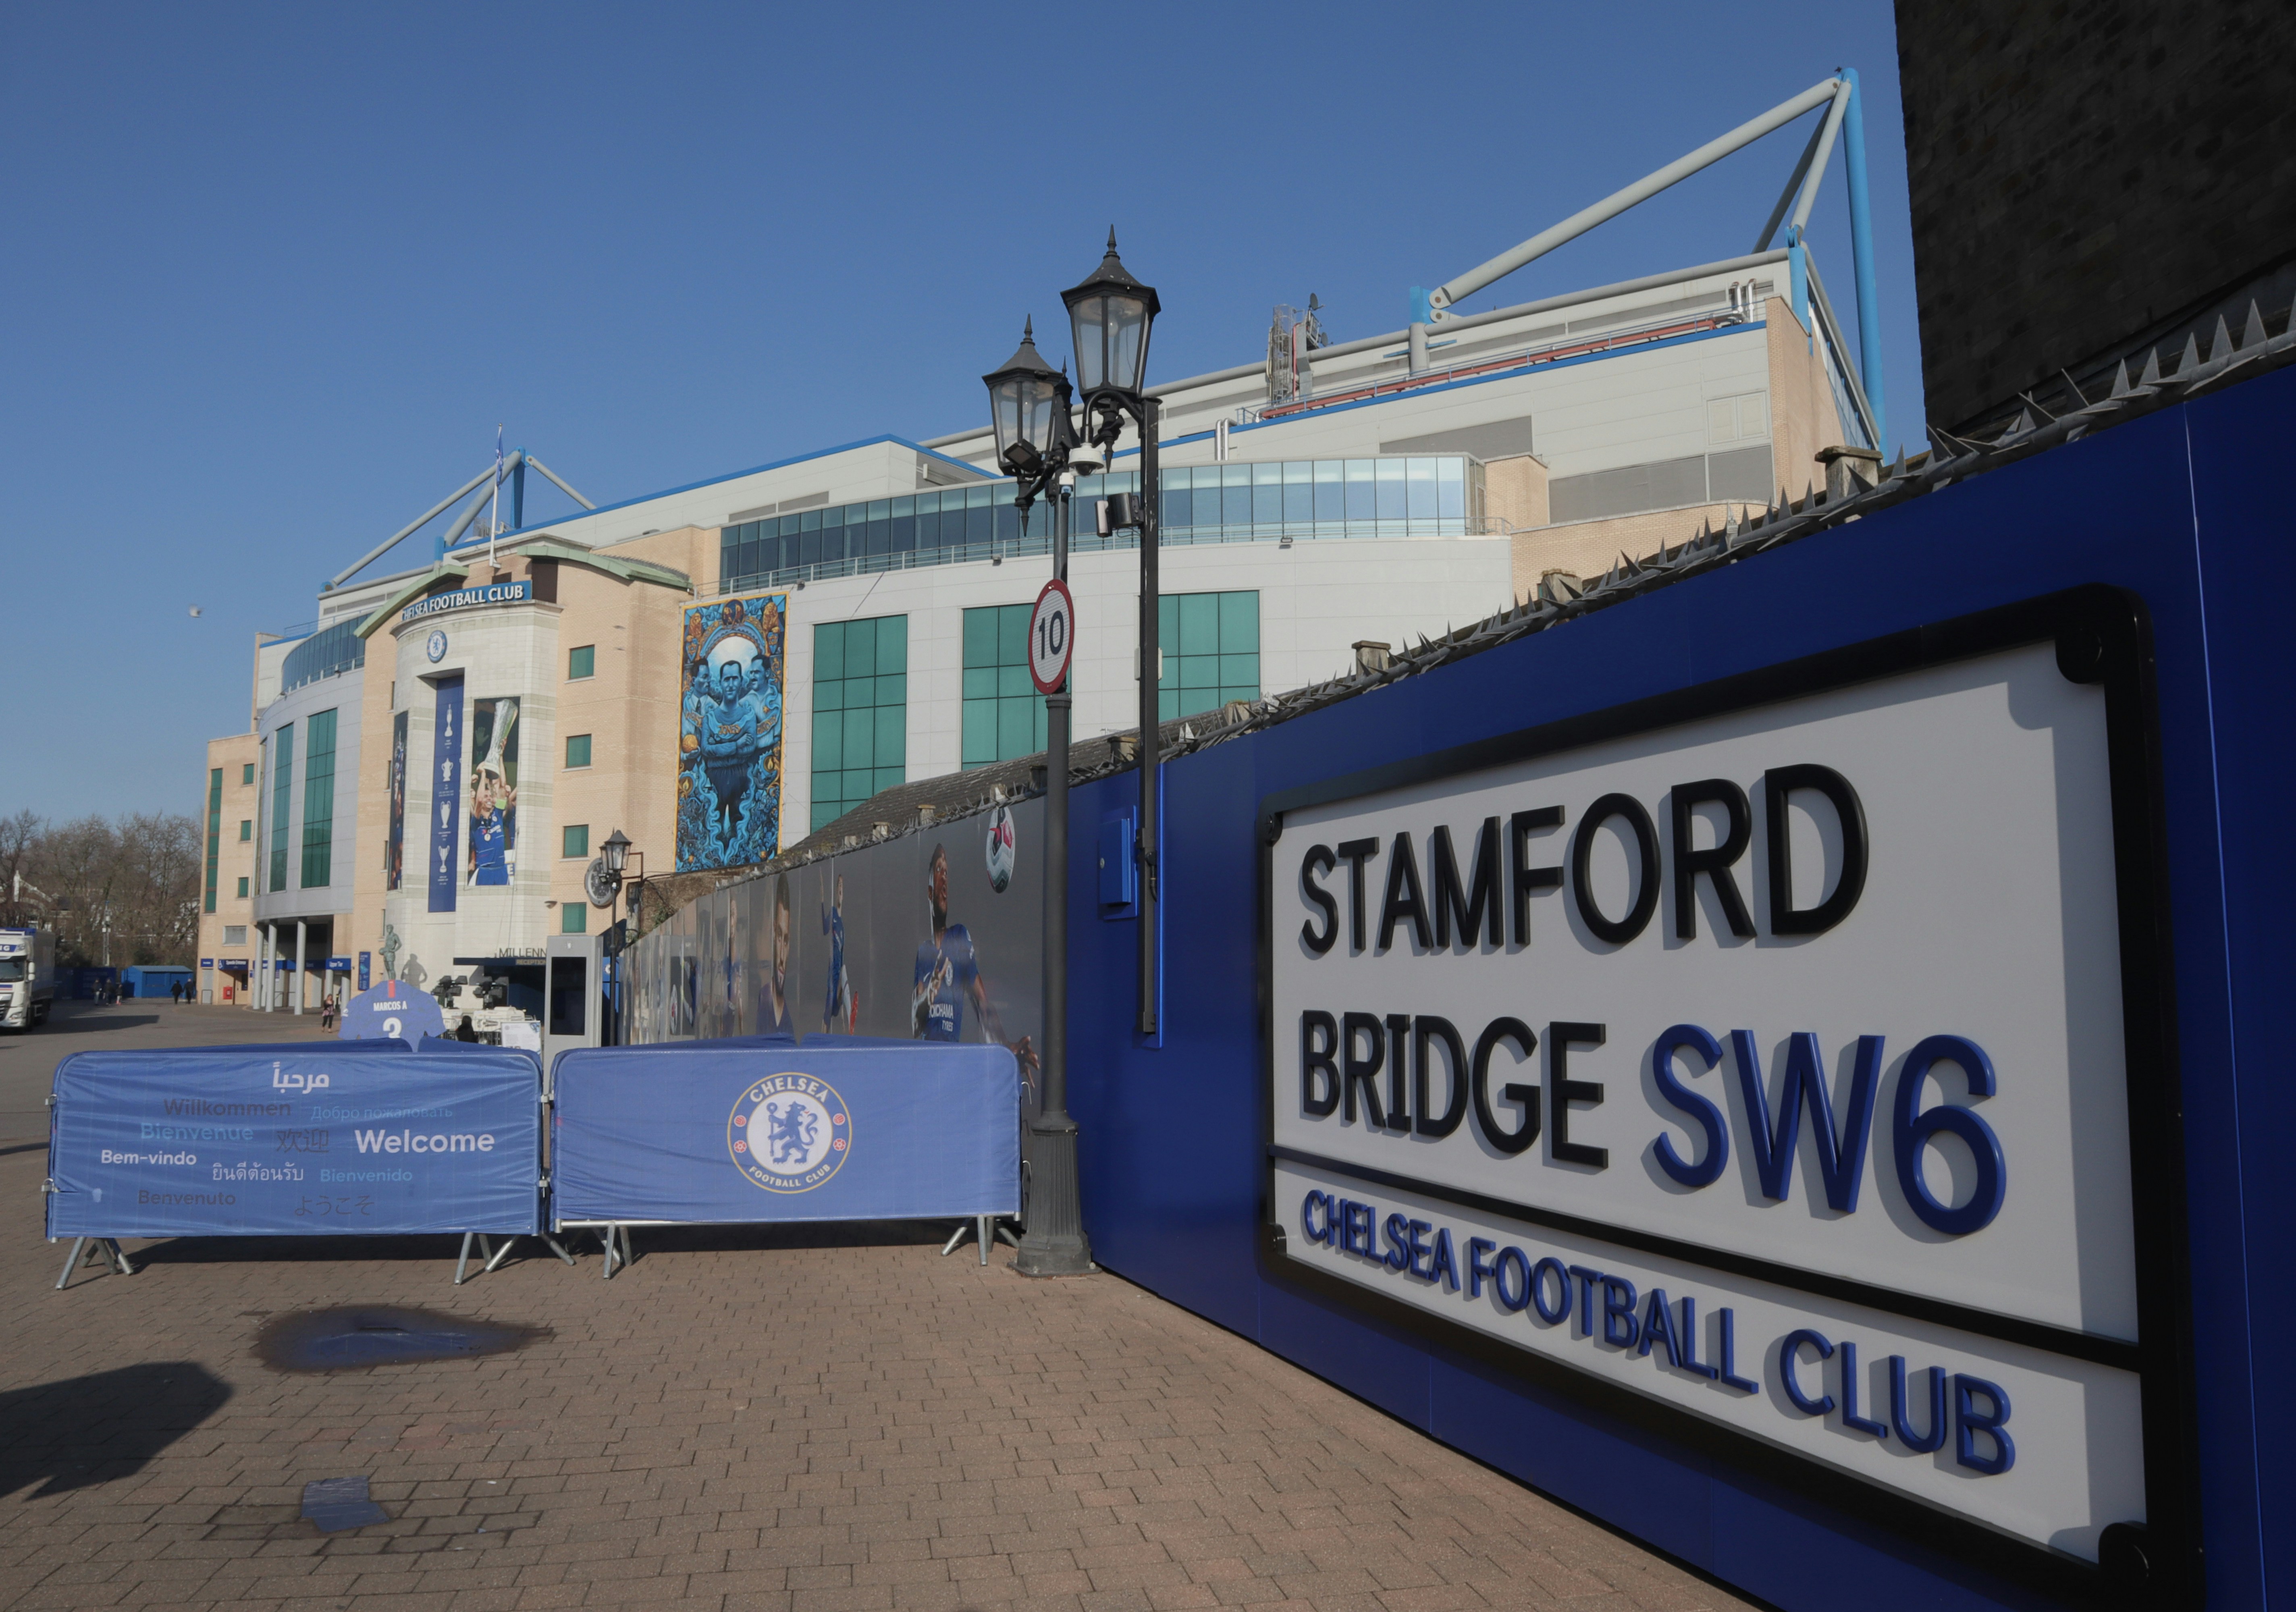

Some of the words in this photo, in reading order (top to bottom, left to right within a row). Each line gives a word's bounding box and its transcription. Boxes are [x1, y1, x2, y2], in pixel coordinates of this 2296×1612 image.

[429, 590, 486, 612] FOOTBALL
[488, 585, 523, 601] CLUB
[1039, 610, 1064, 660] 10
[1302, 763, 1869, 953] STAMFORD
[373, 1001, 401, 1012] MARCOS
[402, 1001, 407, 1010] A
[942, 1020, 954, 1032] TYRES
[750, 1077, 829, 1103] CHELSEA
[164, 1099, 291, 1116] Willkommen
[311, 1106, 359, 1122] Добро
[364, 1107, 453, 1119] пожаловать
[141, 1122, 254, 1140] Bienvenue
[1303, 1010, 1608, 1170] BRIDGE
[1652, 1024, 2007, 1235] SW6
[276, 1129, 329, 1153] 欢迎
[354, 1129, 495, 1153] Welcome
[101, 1150, 197, 1165] Bem-vindo
[212, 1162, 304, 1181] ยินดีต้อนรับ
[320, 1168, 413, 1182] Bienvenido
[749, 1166, 801, 1187] FOOTBALL
[805, 1164, 831, 1183] CLUB
[138, 1190, 236, 1205] Benvenuto
[294, 1195, 375, 1216] ようこそ
[1304, 1189, 1461, 1291] CHELSEA
[1470, 1237, 1759, 1394] FOOTBALL
[1780, 1329, 2015, 1475] CLUB
